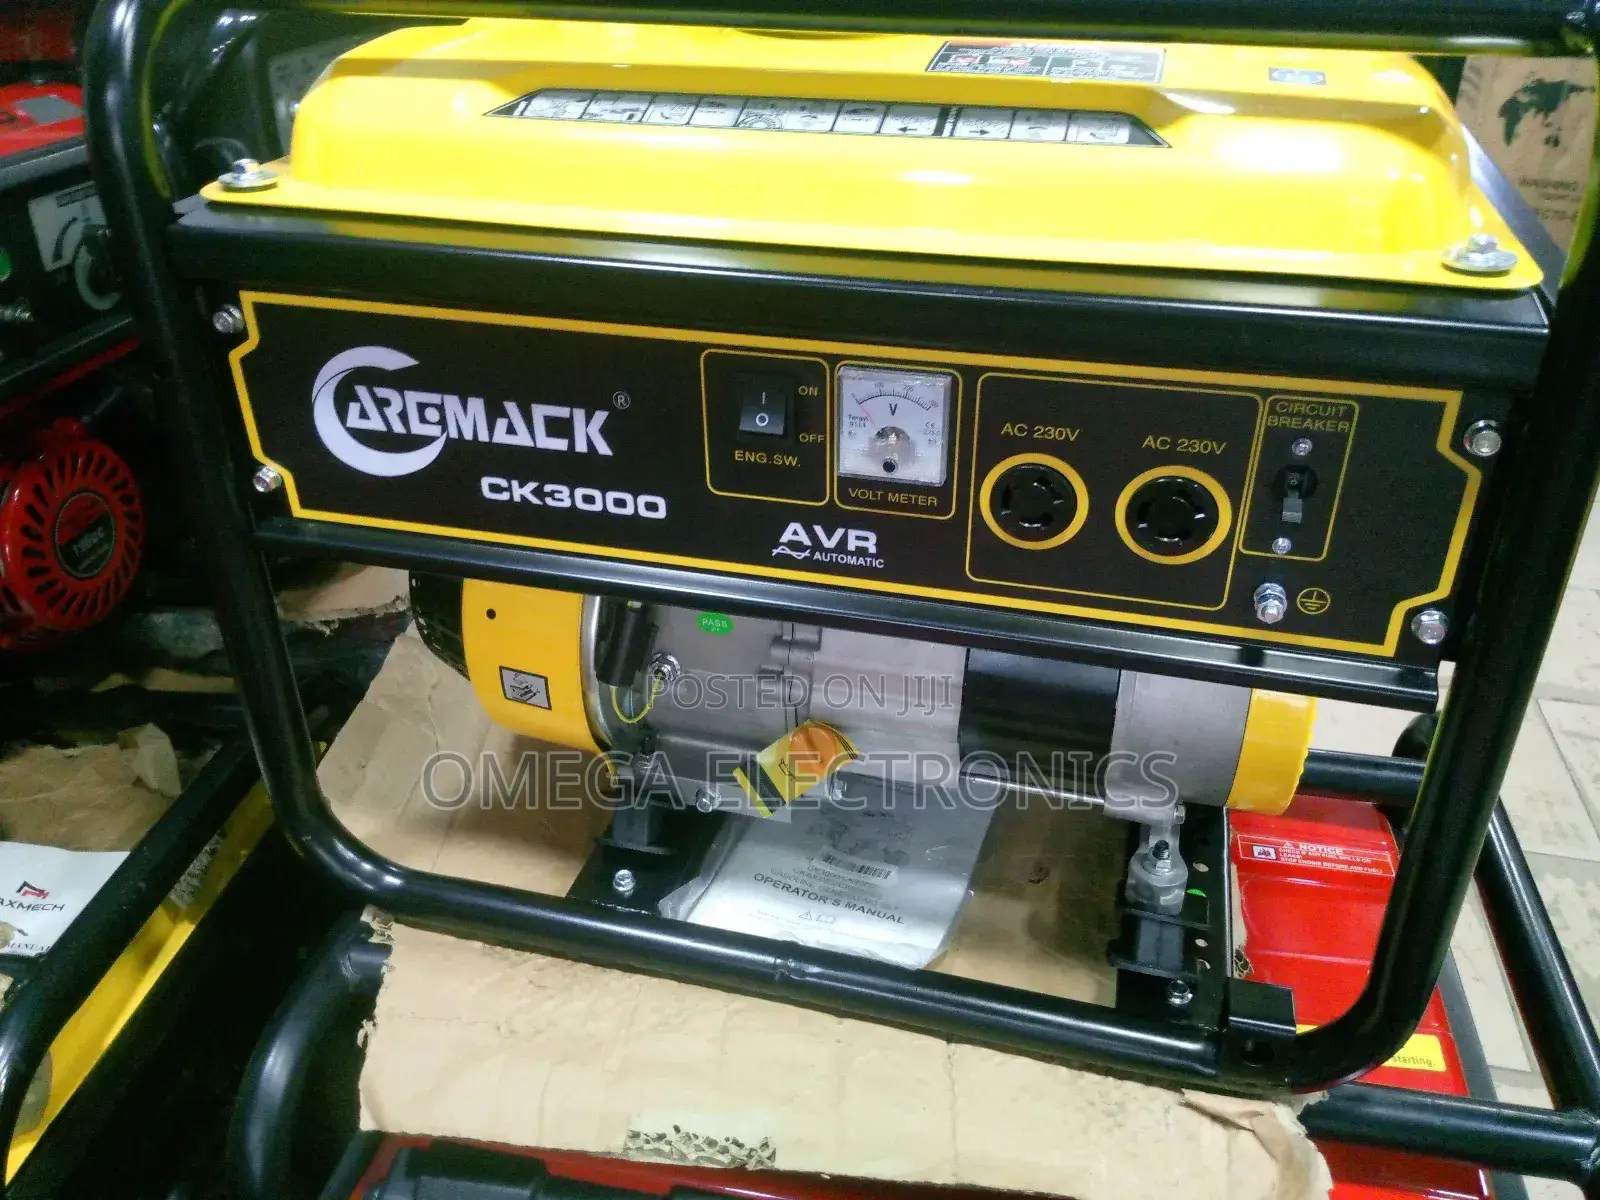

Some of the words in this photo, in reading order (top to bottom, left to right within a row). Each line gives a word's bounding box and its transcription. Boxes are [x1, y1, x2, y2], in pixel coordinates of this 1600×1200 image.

[798, 385, 819, 397] ON
[888, 403, 898, 416] V
[1275, 401, 1348, 417] CIRCUIT
[1000, 422, 1028, 437] AC
[1032, 424, 1080, 442] 230V
[1267, 415, 1350, 433] BREAKER
[799, 432, 825, 443] OFF
[1142, 435, 1171, 450] AC
[1176, 438, 1227, 456] 230V
[480, 475, 668, 520] CK3000
[848, 487, 884, 501] VOLT
[887, 492, 939, 507] METER
[779, 521, 878, 554] AVR
[813, 551, 885, 569] AUTOMATIC
[1300, 843, 1344, 856] NOTICE
[753, 872, 841, 907] OPERATOR'S
[844, 901, 905, 925] MANUAL
